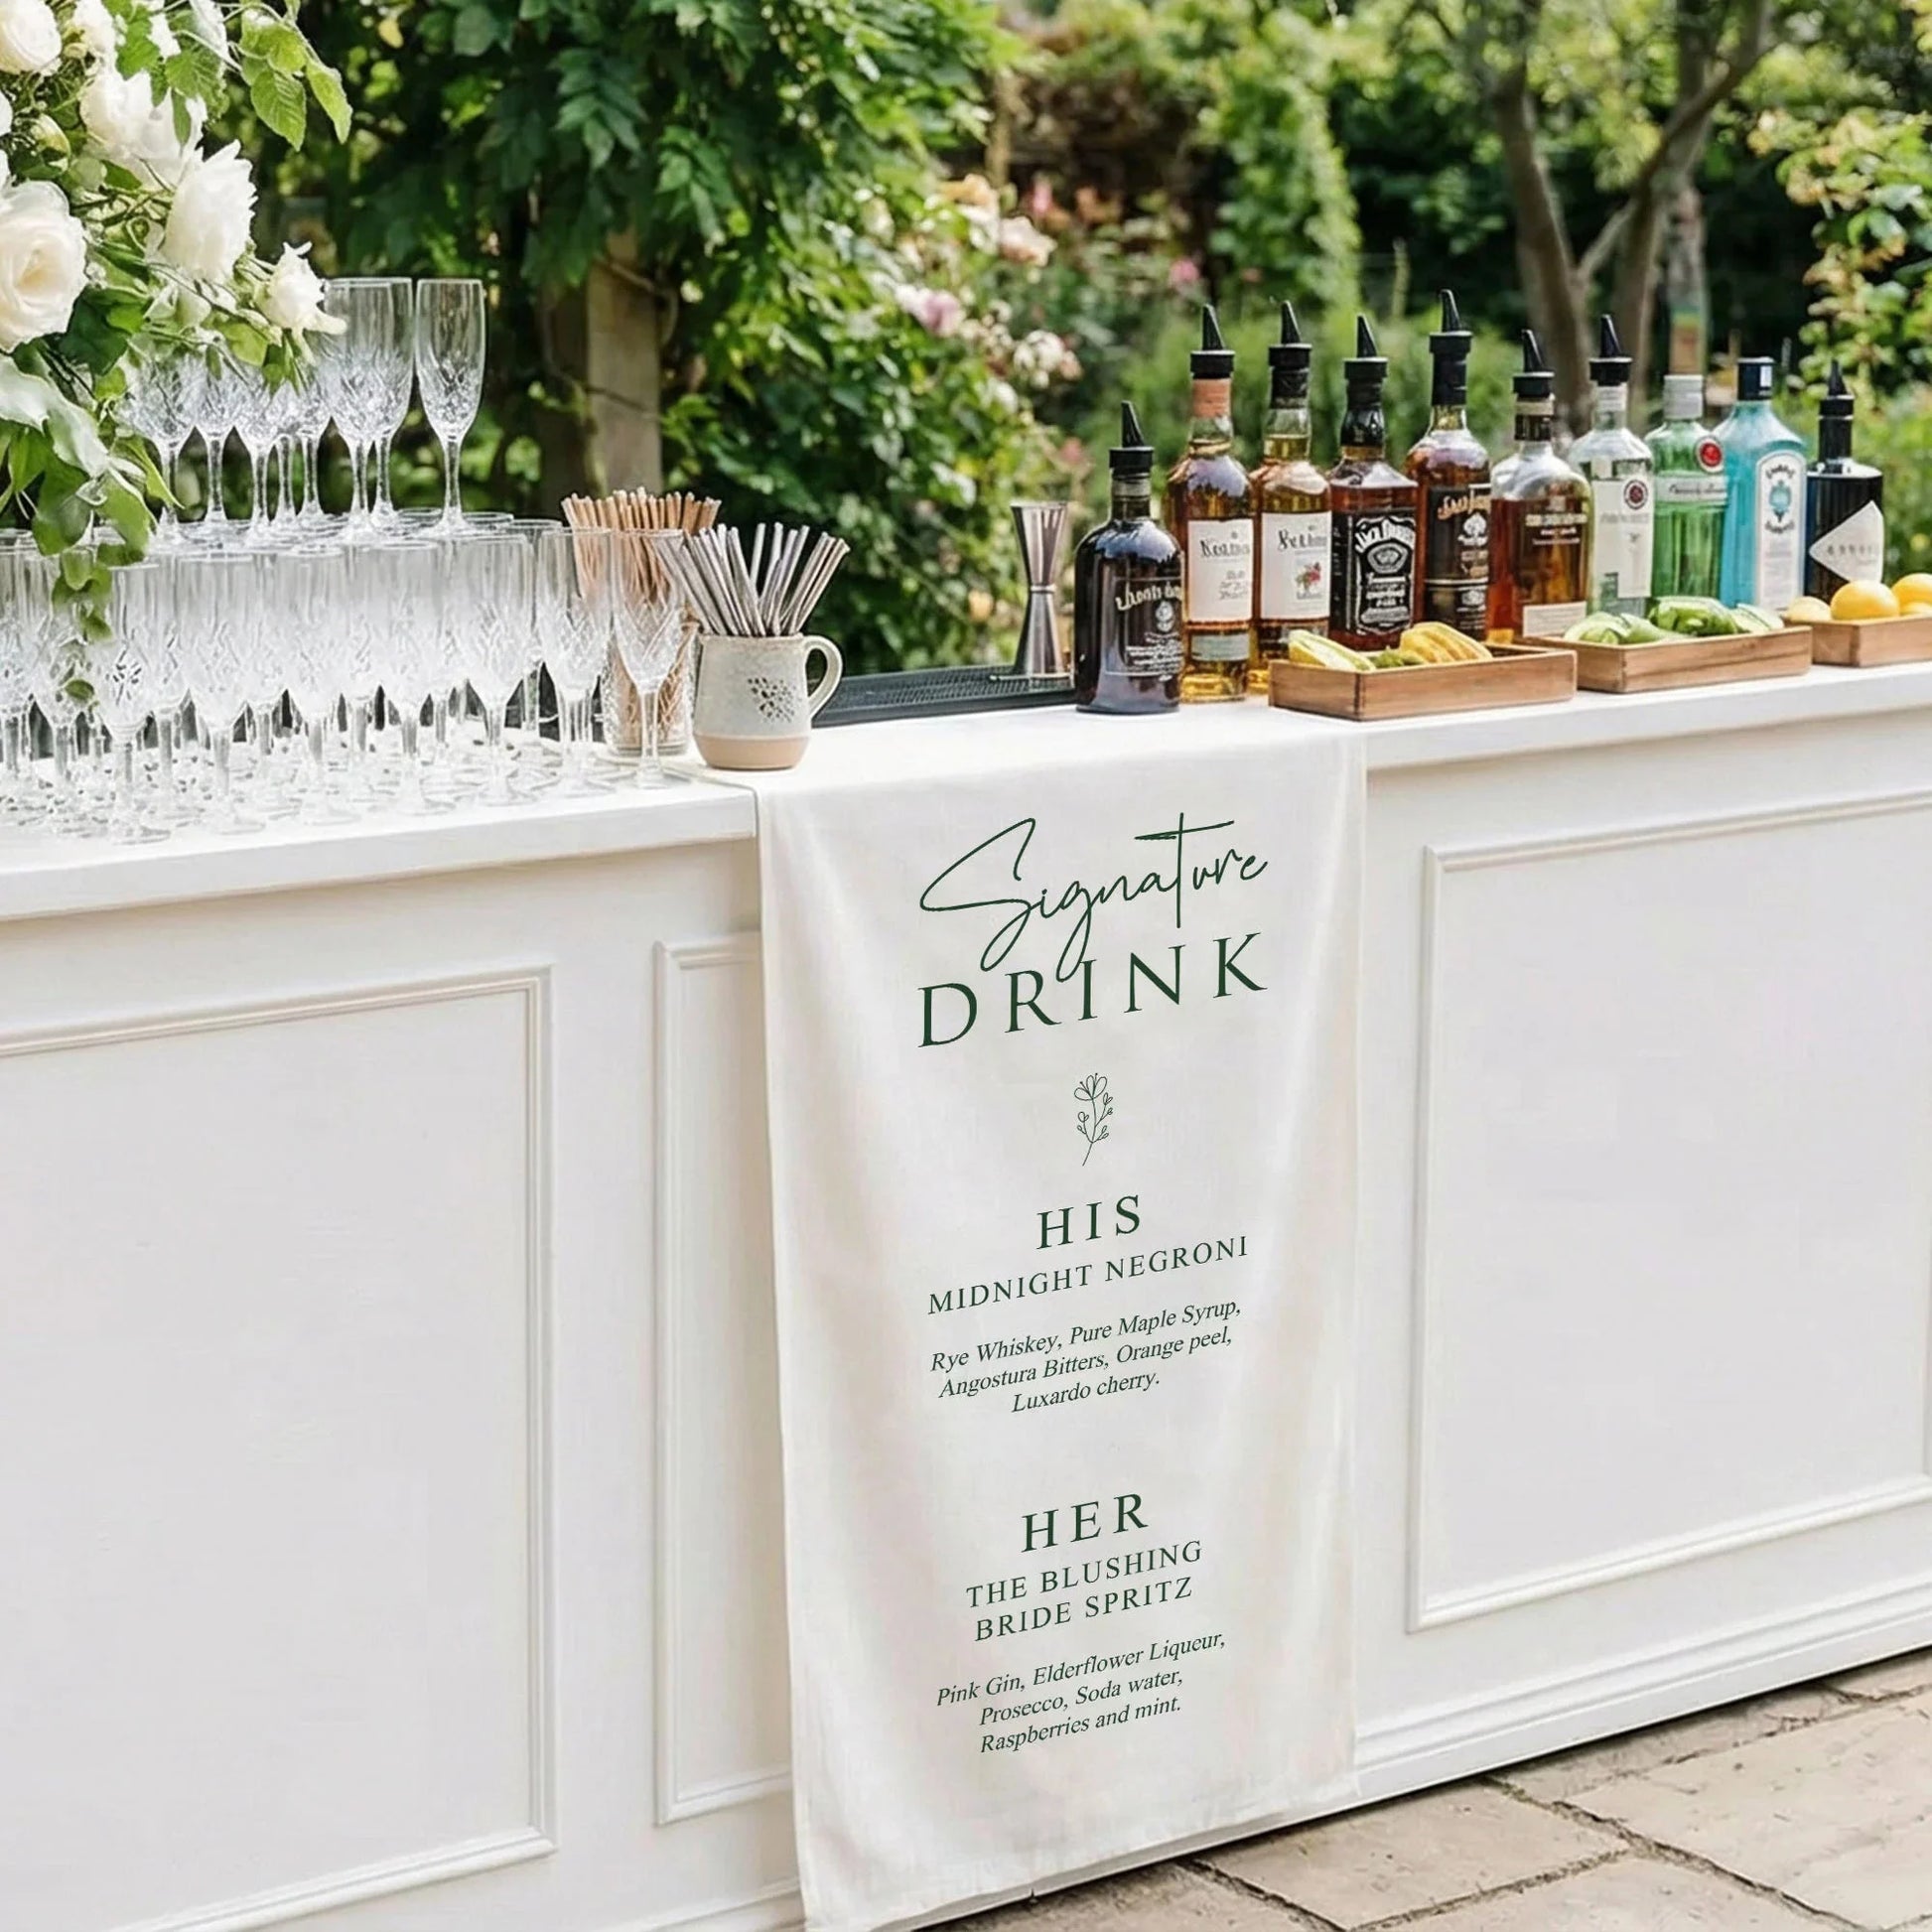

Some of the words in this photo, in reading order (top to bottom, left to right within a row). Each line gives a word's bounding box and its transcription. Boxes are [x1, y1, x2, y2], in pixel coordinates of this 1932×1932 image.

[919, 812, 1269, 982] Signature
[918, 932, 1269, 1047] DRINK
[1036, 1194, 1141, 1250] HIS
[927, 1265, 1093, 1314] MIDNIGHT
[1104, 1236, 1248, 1282] NEGRONI
[930, 1352, 970, 1373] Rye
[976, 1334, 1062, 1363] Whiskey,
[1069, 1324, 1113, 1345] Pure
[1117, 1310, 1177, 1336] Maple
[1181, 1301, 1241, 1326] Syrup,
[938, 1368, 1036, 1399] Angostura
[1041, 1354, 1110, 1379] Bitters,
[1116, 1339, 1184, 1363] Orange
[1187, 1325, 1232, 1355] peel,
[1011, 1381, 1092, 1413] Luxardo
[1096, 1372, 1161, 1396] cherry.
[1021, 1493, 1149, 1554] HER
[965, 1577, 1028, 1608] THE
[1040, 1540, 1202, 1593] BLUSHING
[974, 1602, 1071, 1642] BRIDE
[1085, 1577, 1192, 1618] SPRITZ
[936, 1683, 980, 1707] Pink
[985, 1674, 1026, 1696] Gin,
[1033, 1650, 1145, 1686] Elderflower
[1149, 1633, 1226, 1662] Liqueur,
[979, 1696, 1069, 1726] Prosecco,
[1075, 1680, 1122, 1706] Soda
[1128, 1671, 1183, 1694] water,
[980, 1716, 1090, 1753] Raspberries
[1094, 1704, 1132, 1728] and
[1135, 1697, 1181, 1720] mint.
